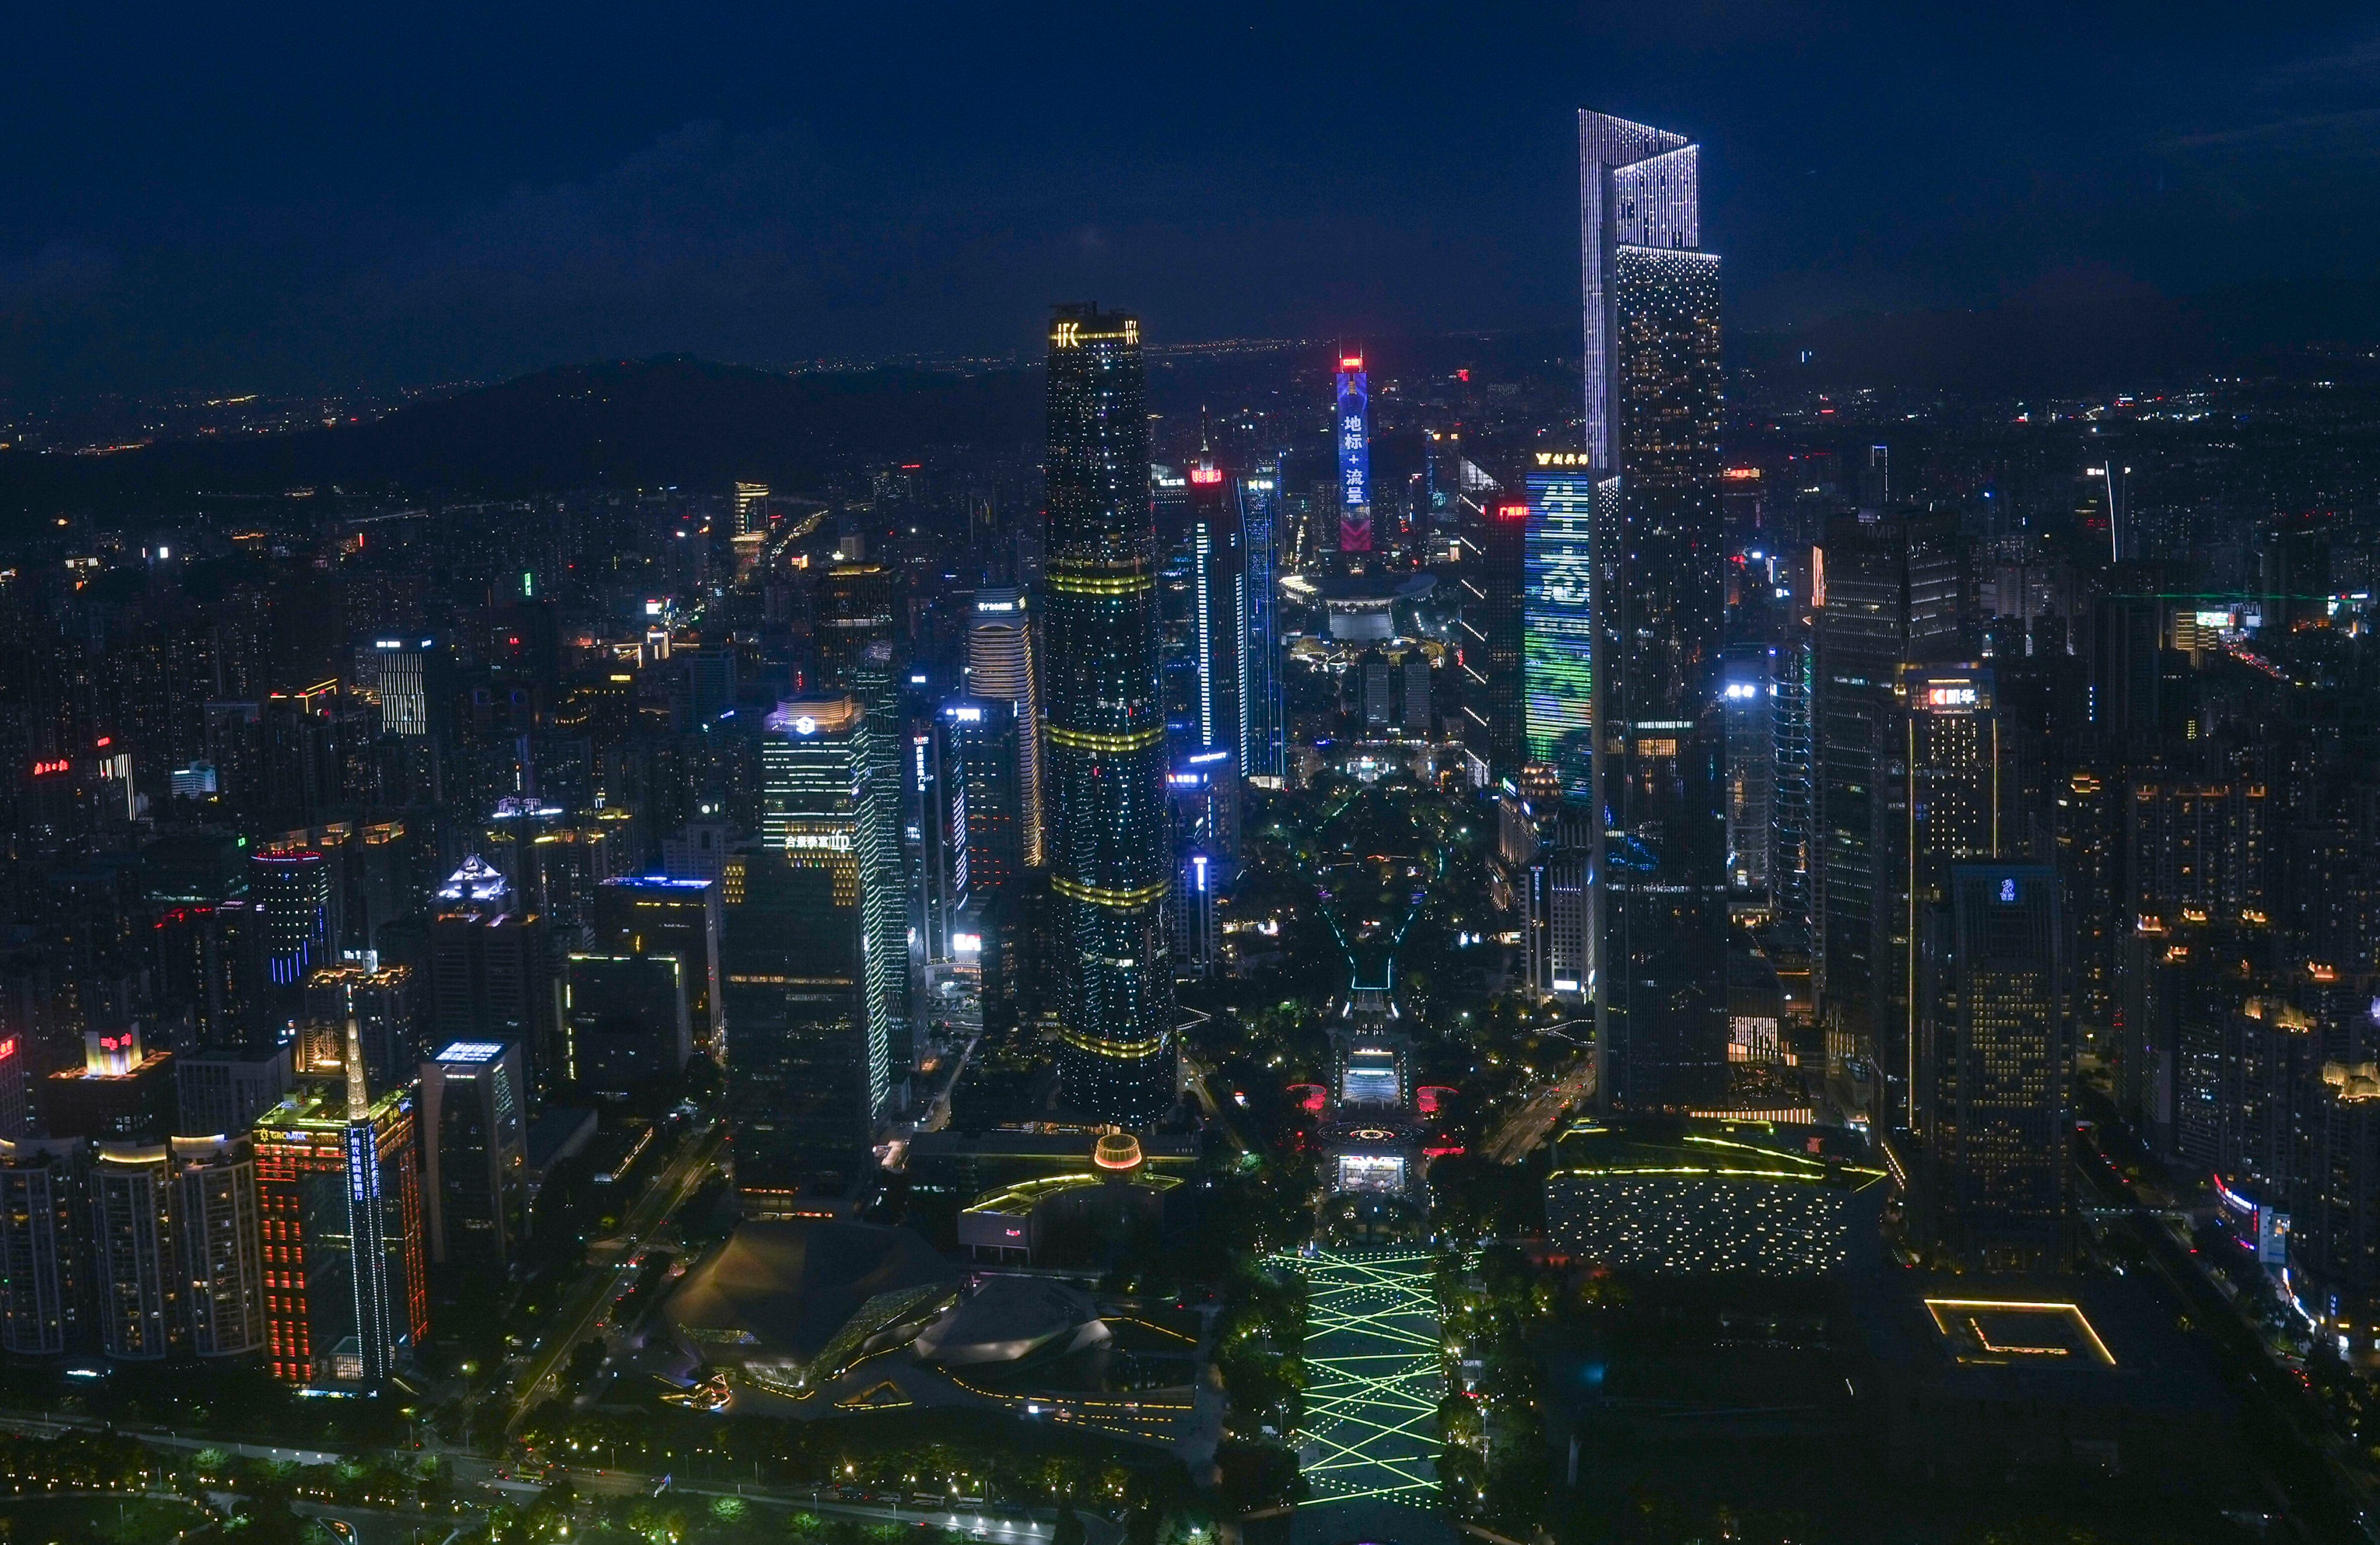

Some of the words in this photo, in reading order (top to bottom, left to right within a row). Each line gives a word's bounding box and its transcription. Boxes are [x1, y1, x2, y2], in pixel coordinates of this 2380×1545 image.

[1058, 323, 1078, 347] IFC
[1125, 320, 1139, 344] IFC
[1344, 415, 1364, 503] 地标+流量
[1499, 507, 1530, 517] 广州银行
[1867, 525, 1897, 539] IMP
[785, 836, 829, 848] 合景泰富
[271, 1132, 307, 1141] GRCBANK
